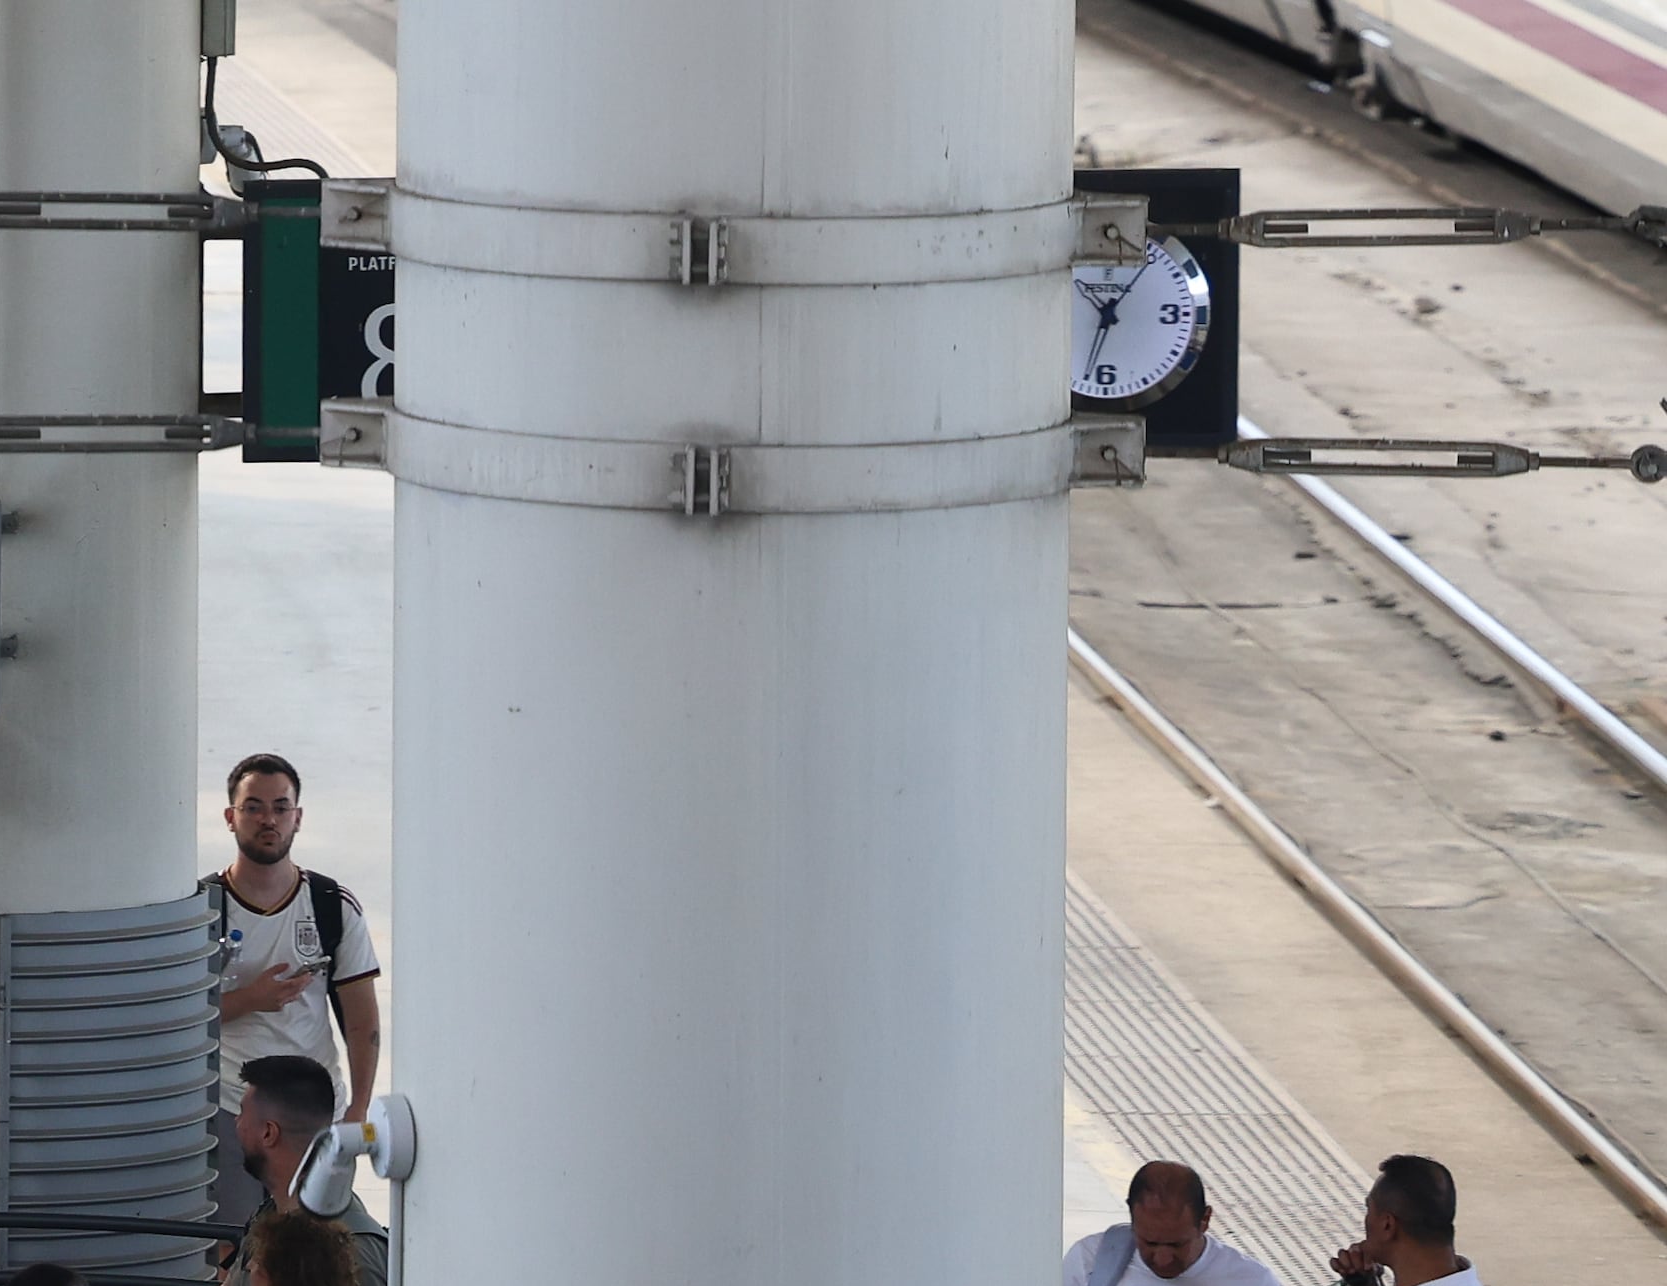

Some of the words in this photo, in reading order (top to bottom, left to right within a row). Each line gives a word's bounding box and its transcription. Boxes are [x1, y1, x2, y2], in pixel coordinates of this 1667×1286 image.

[348, 256, 395, 271] PLATF
[1159, 304, 1180, 324] 3
[1096, 364, 1117, 385] 6
